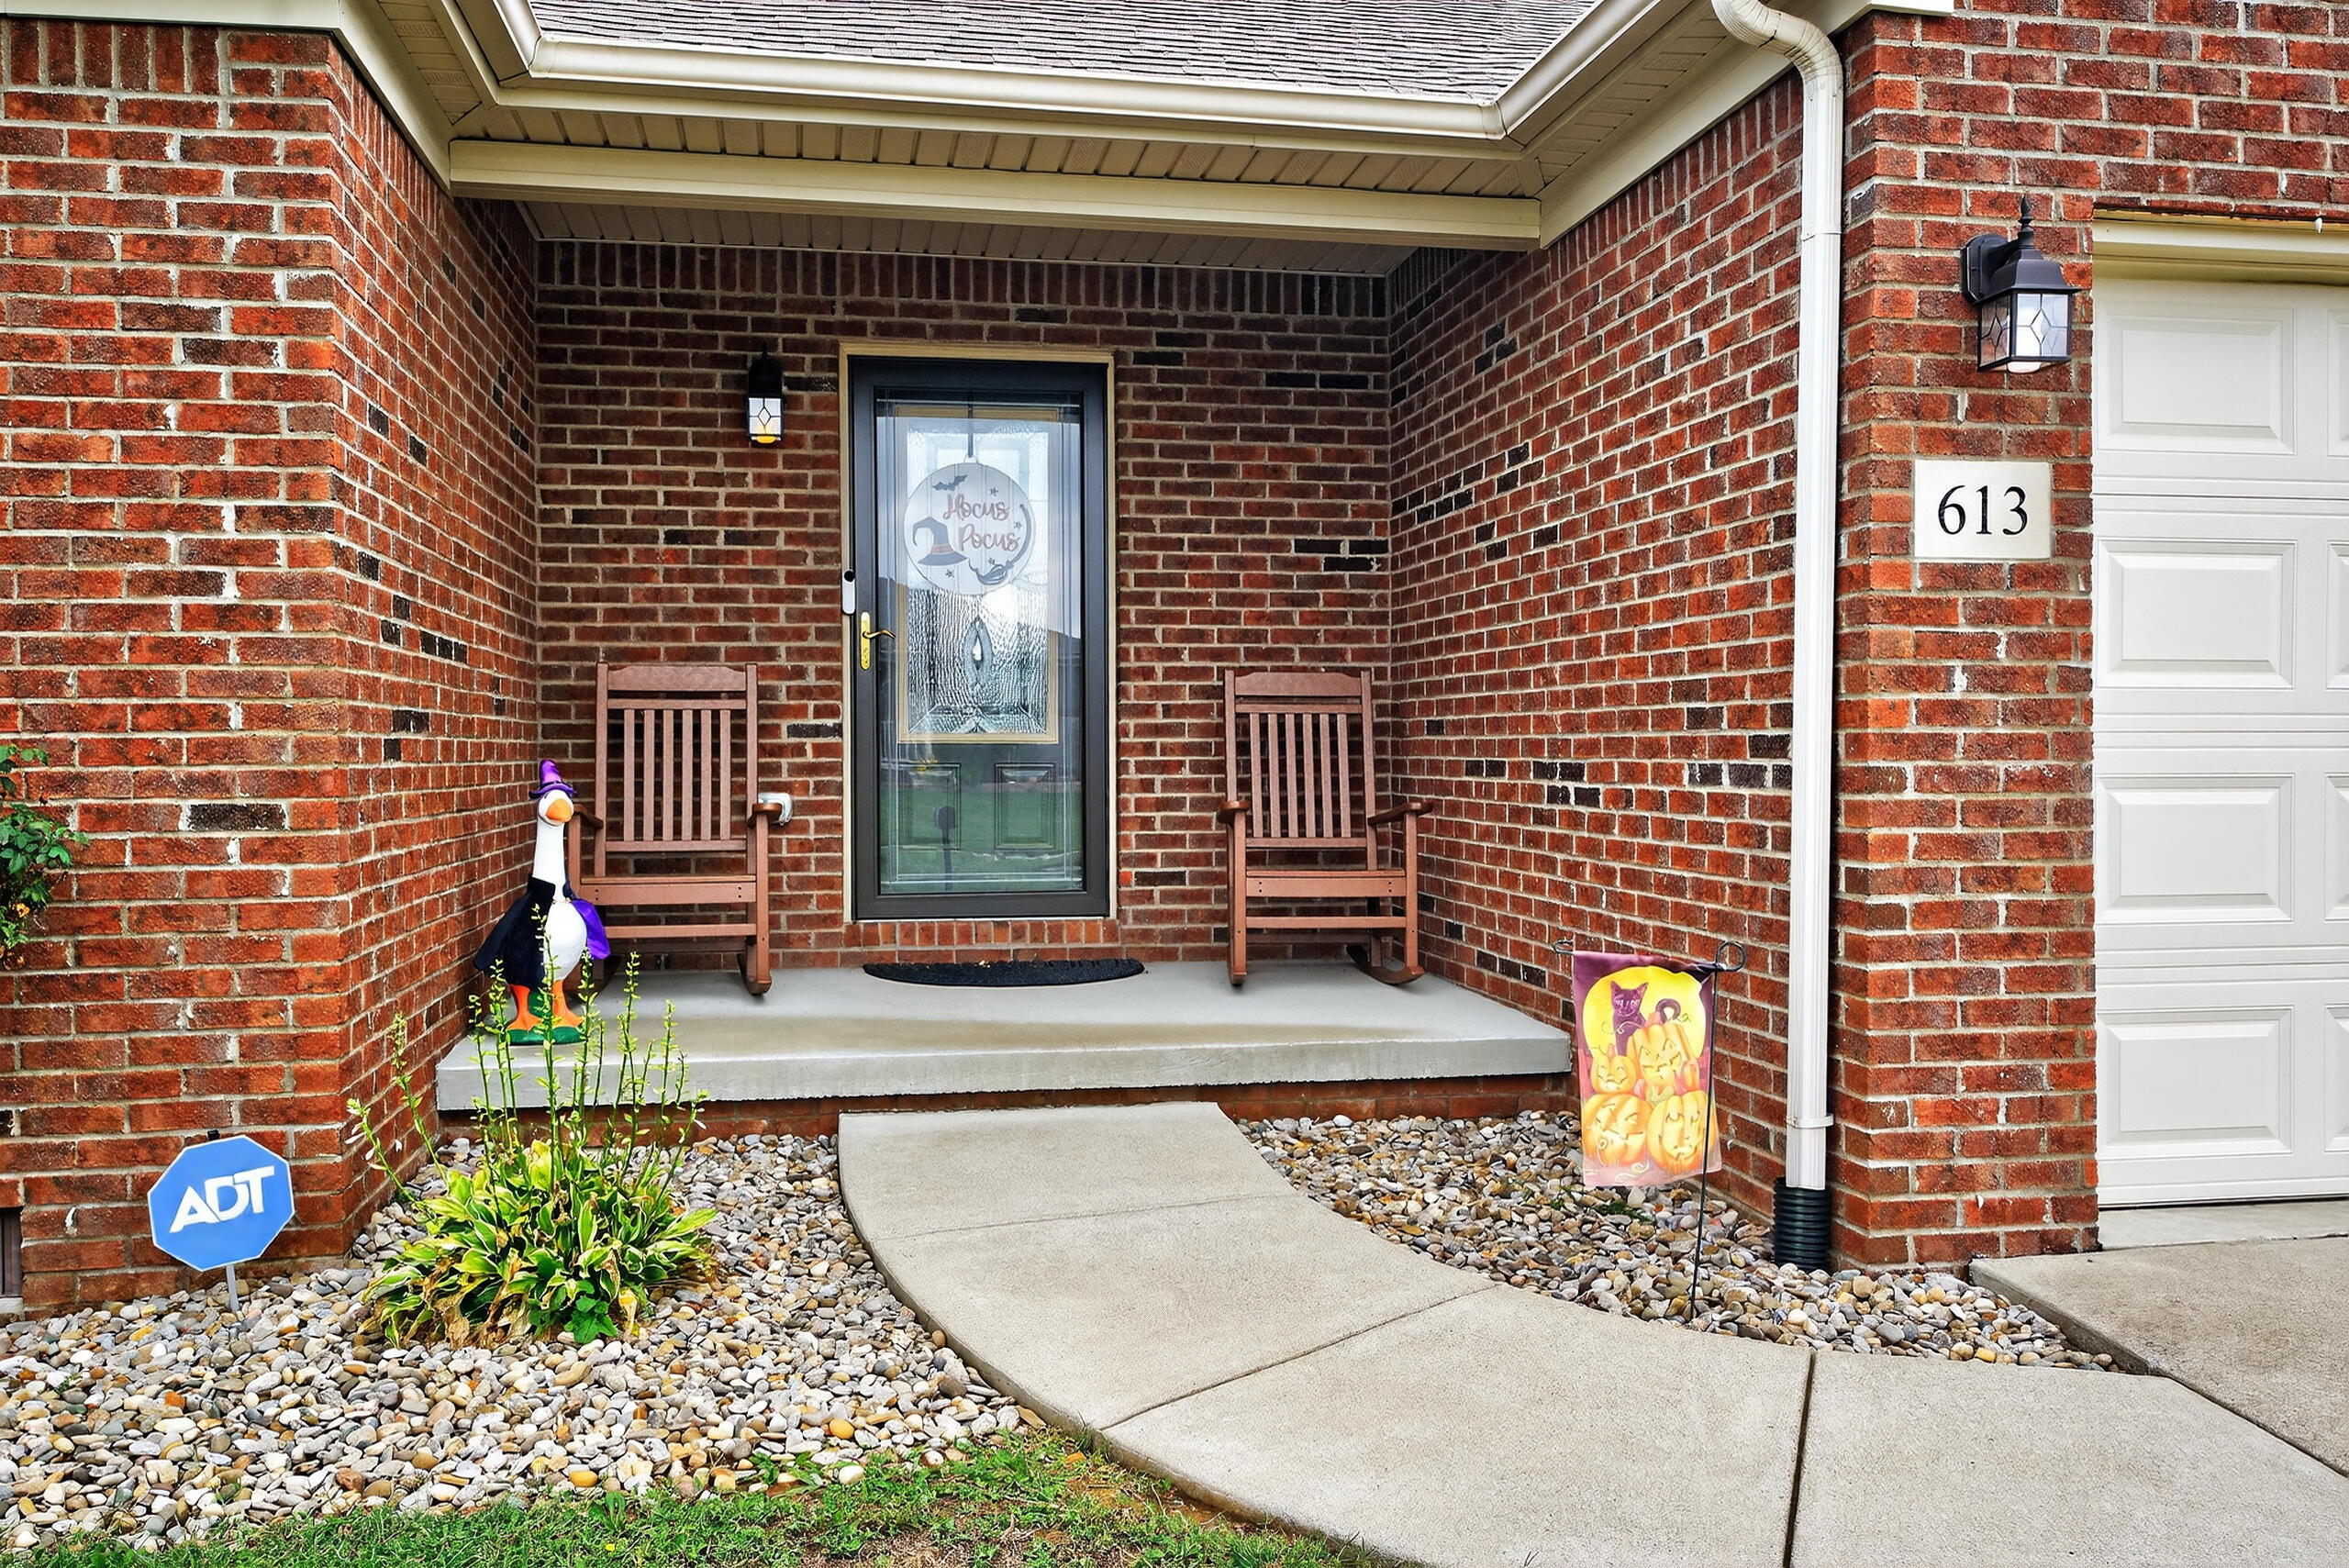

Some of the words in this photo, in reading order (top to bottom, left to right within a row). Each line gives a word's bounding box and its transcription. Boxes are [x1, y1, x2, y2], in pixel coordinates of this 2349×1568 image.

[942, 493, 1010, 521] Hocus
[1938, 484, 2028, 536] 613
[958, 523, 1020, 551] Pocus
[169, 1165, 275, 1234] ADT
